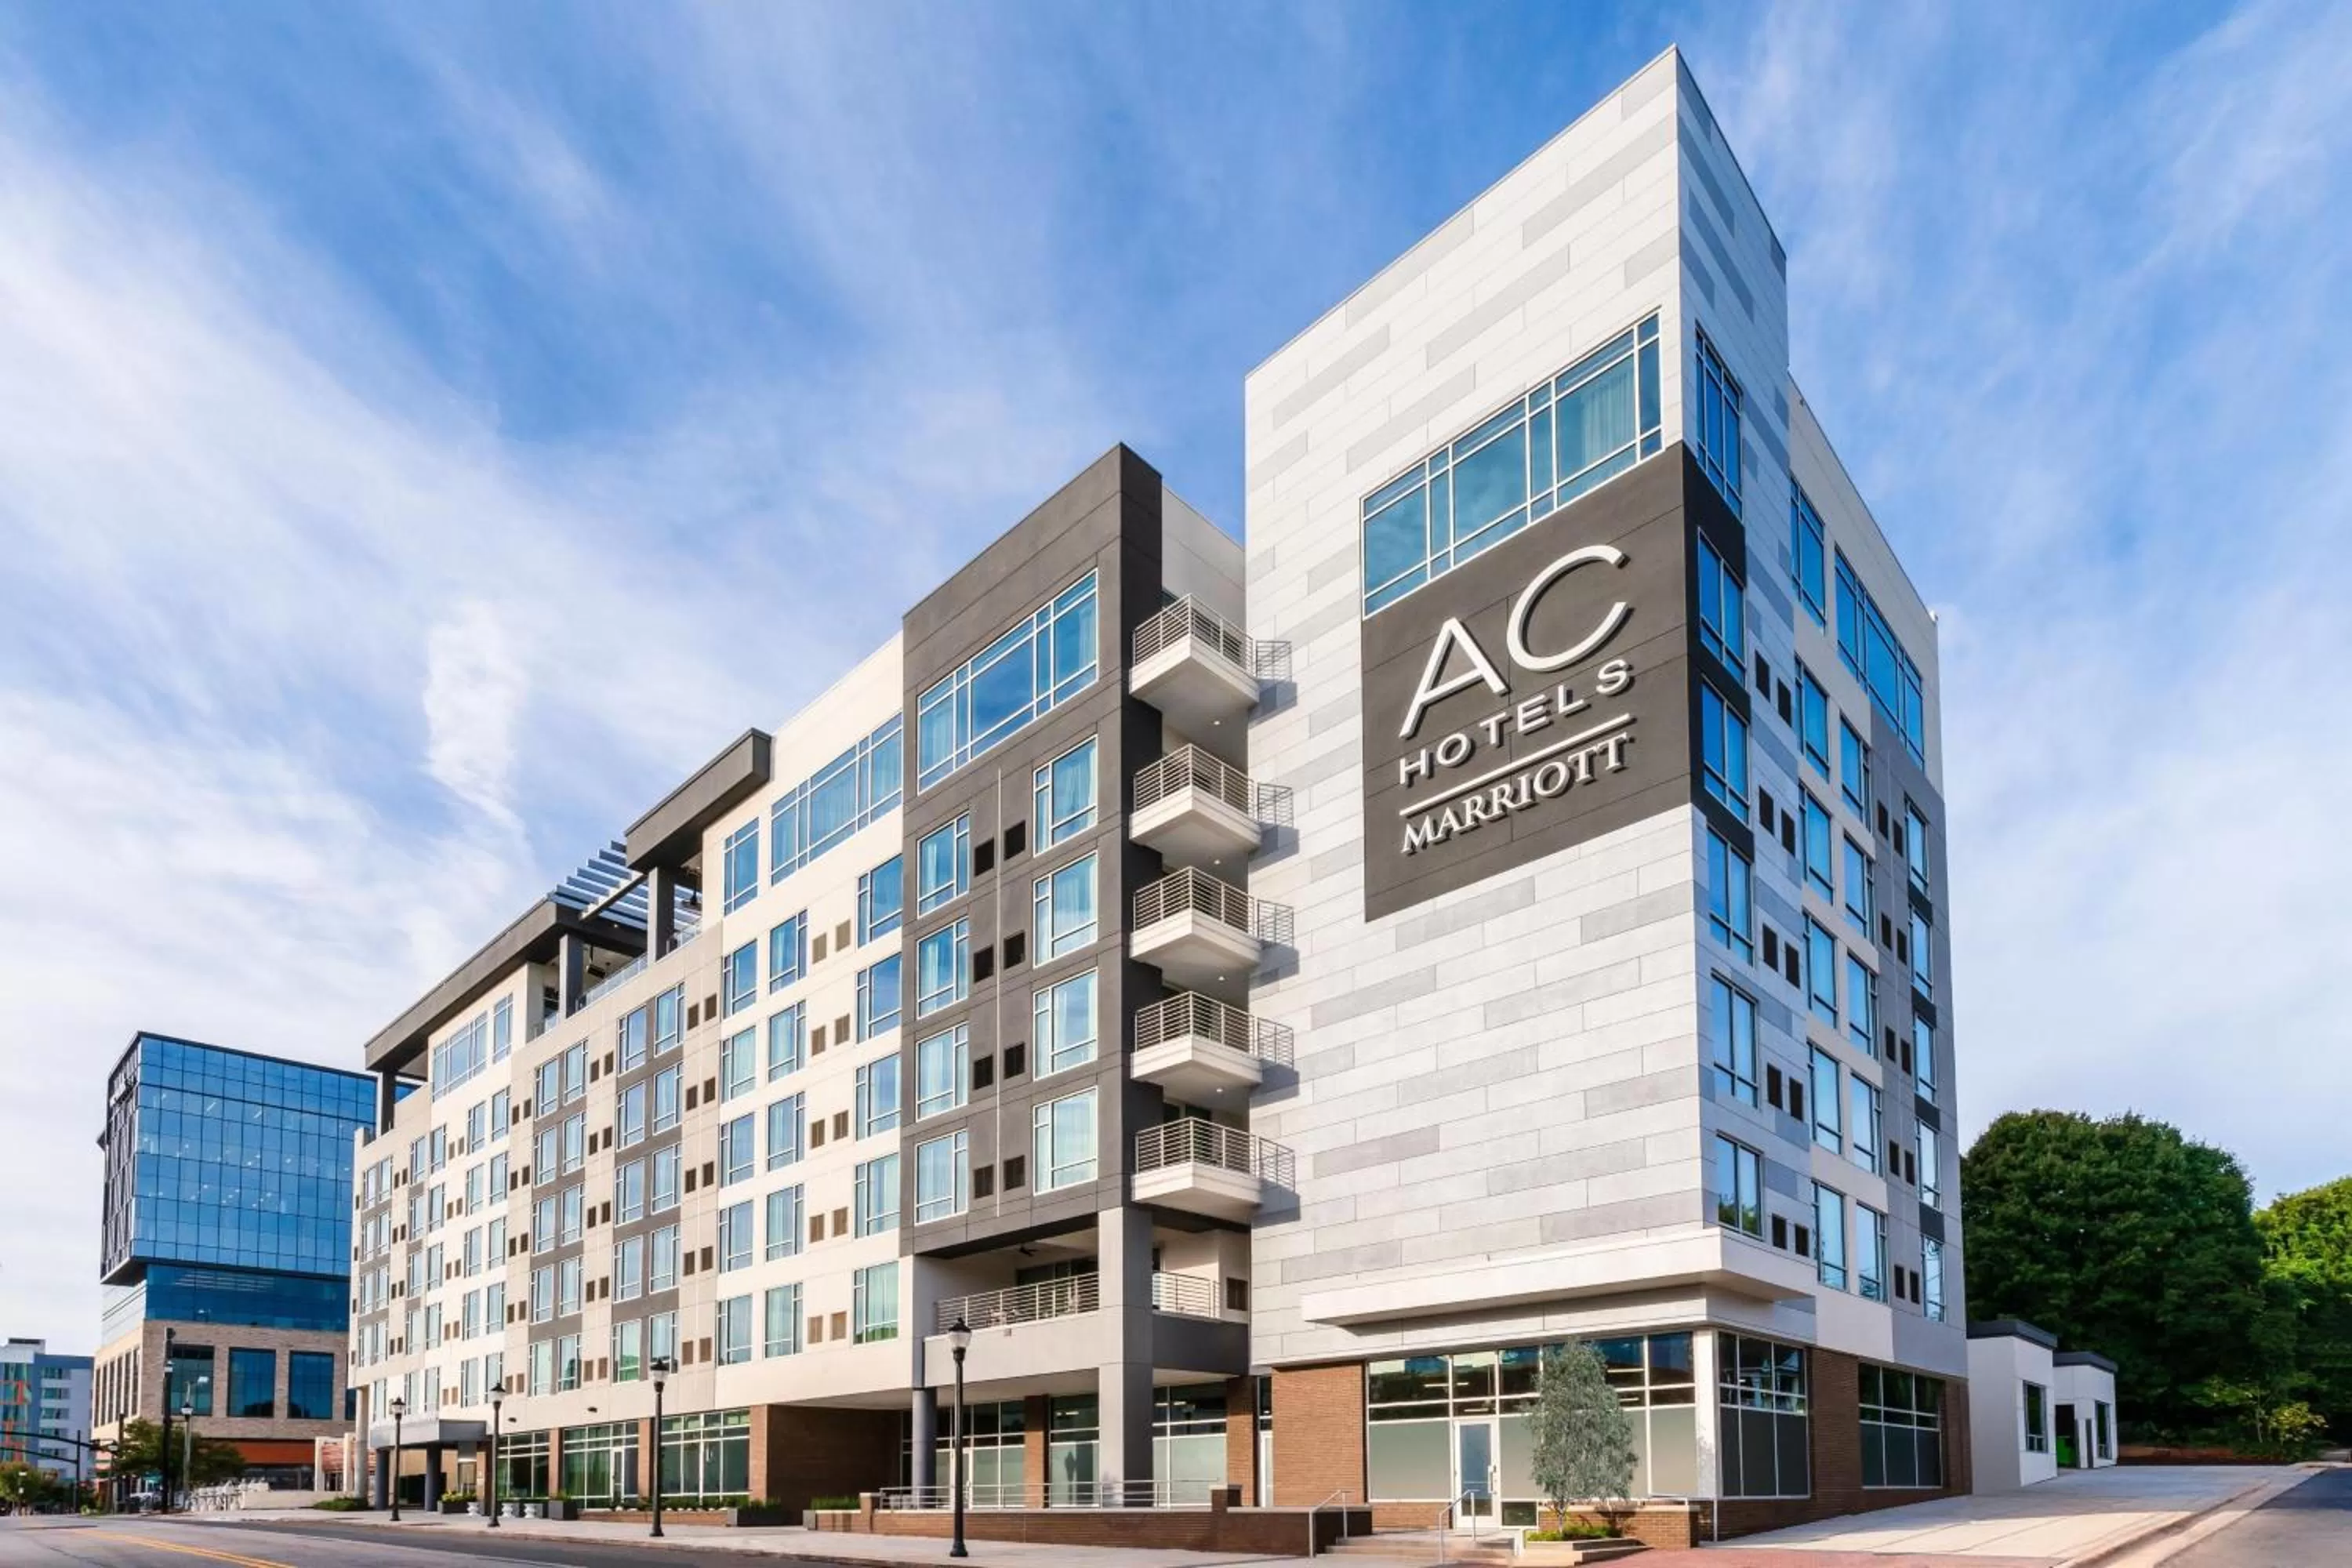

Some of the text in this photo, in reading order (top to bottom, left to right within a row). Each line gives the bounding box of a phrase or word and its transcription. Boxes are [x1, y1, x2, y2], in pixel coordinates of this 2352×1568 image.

[1399, 544, 1628, 738] AC
[1399, 659, 1631, 784] HOTELS
[1401, 732, 1628, 854] MARRIOTT
